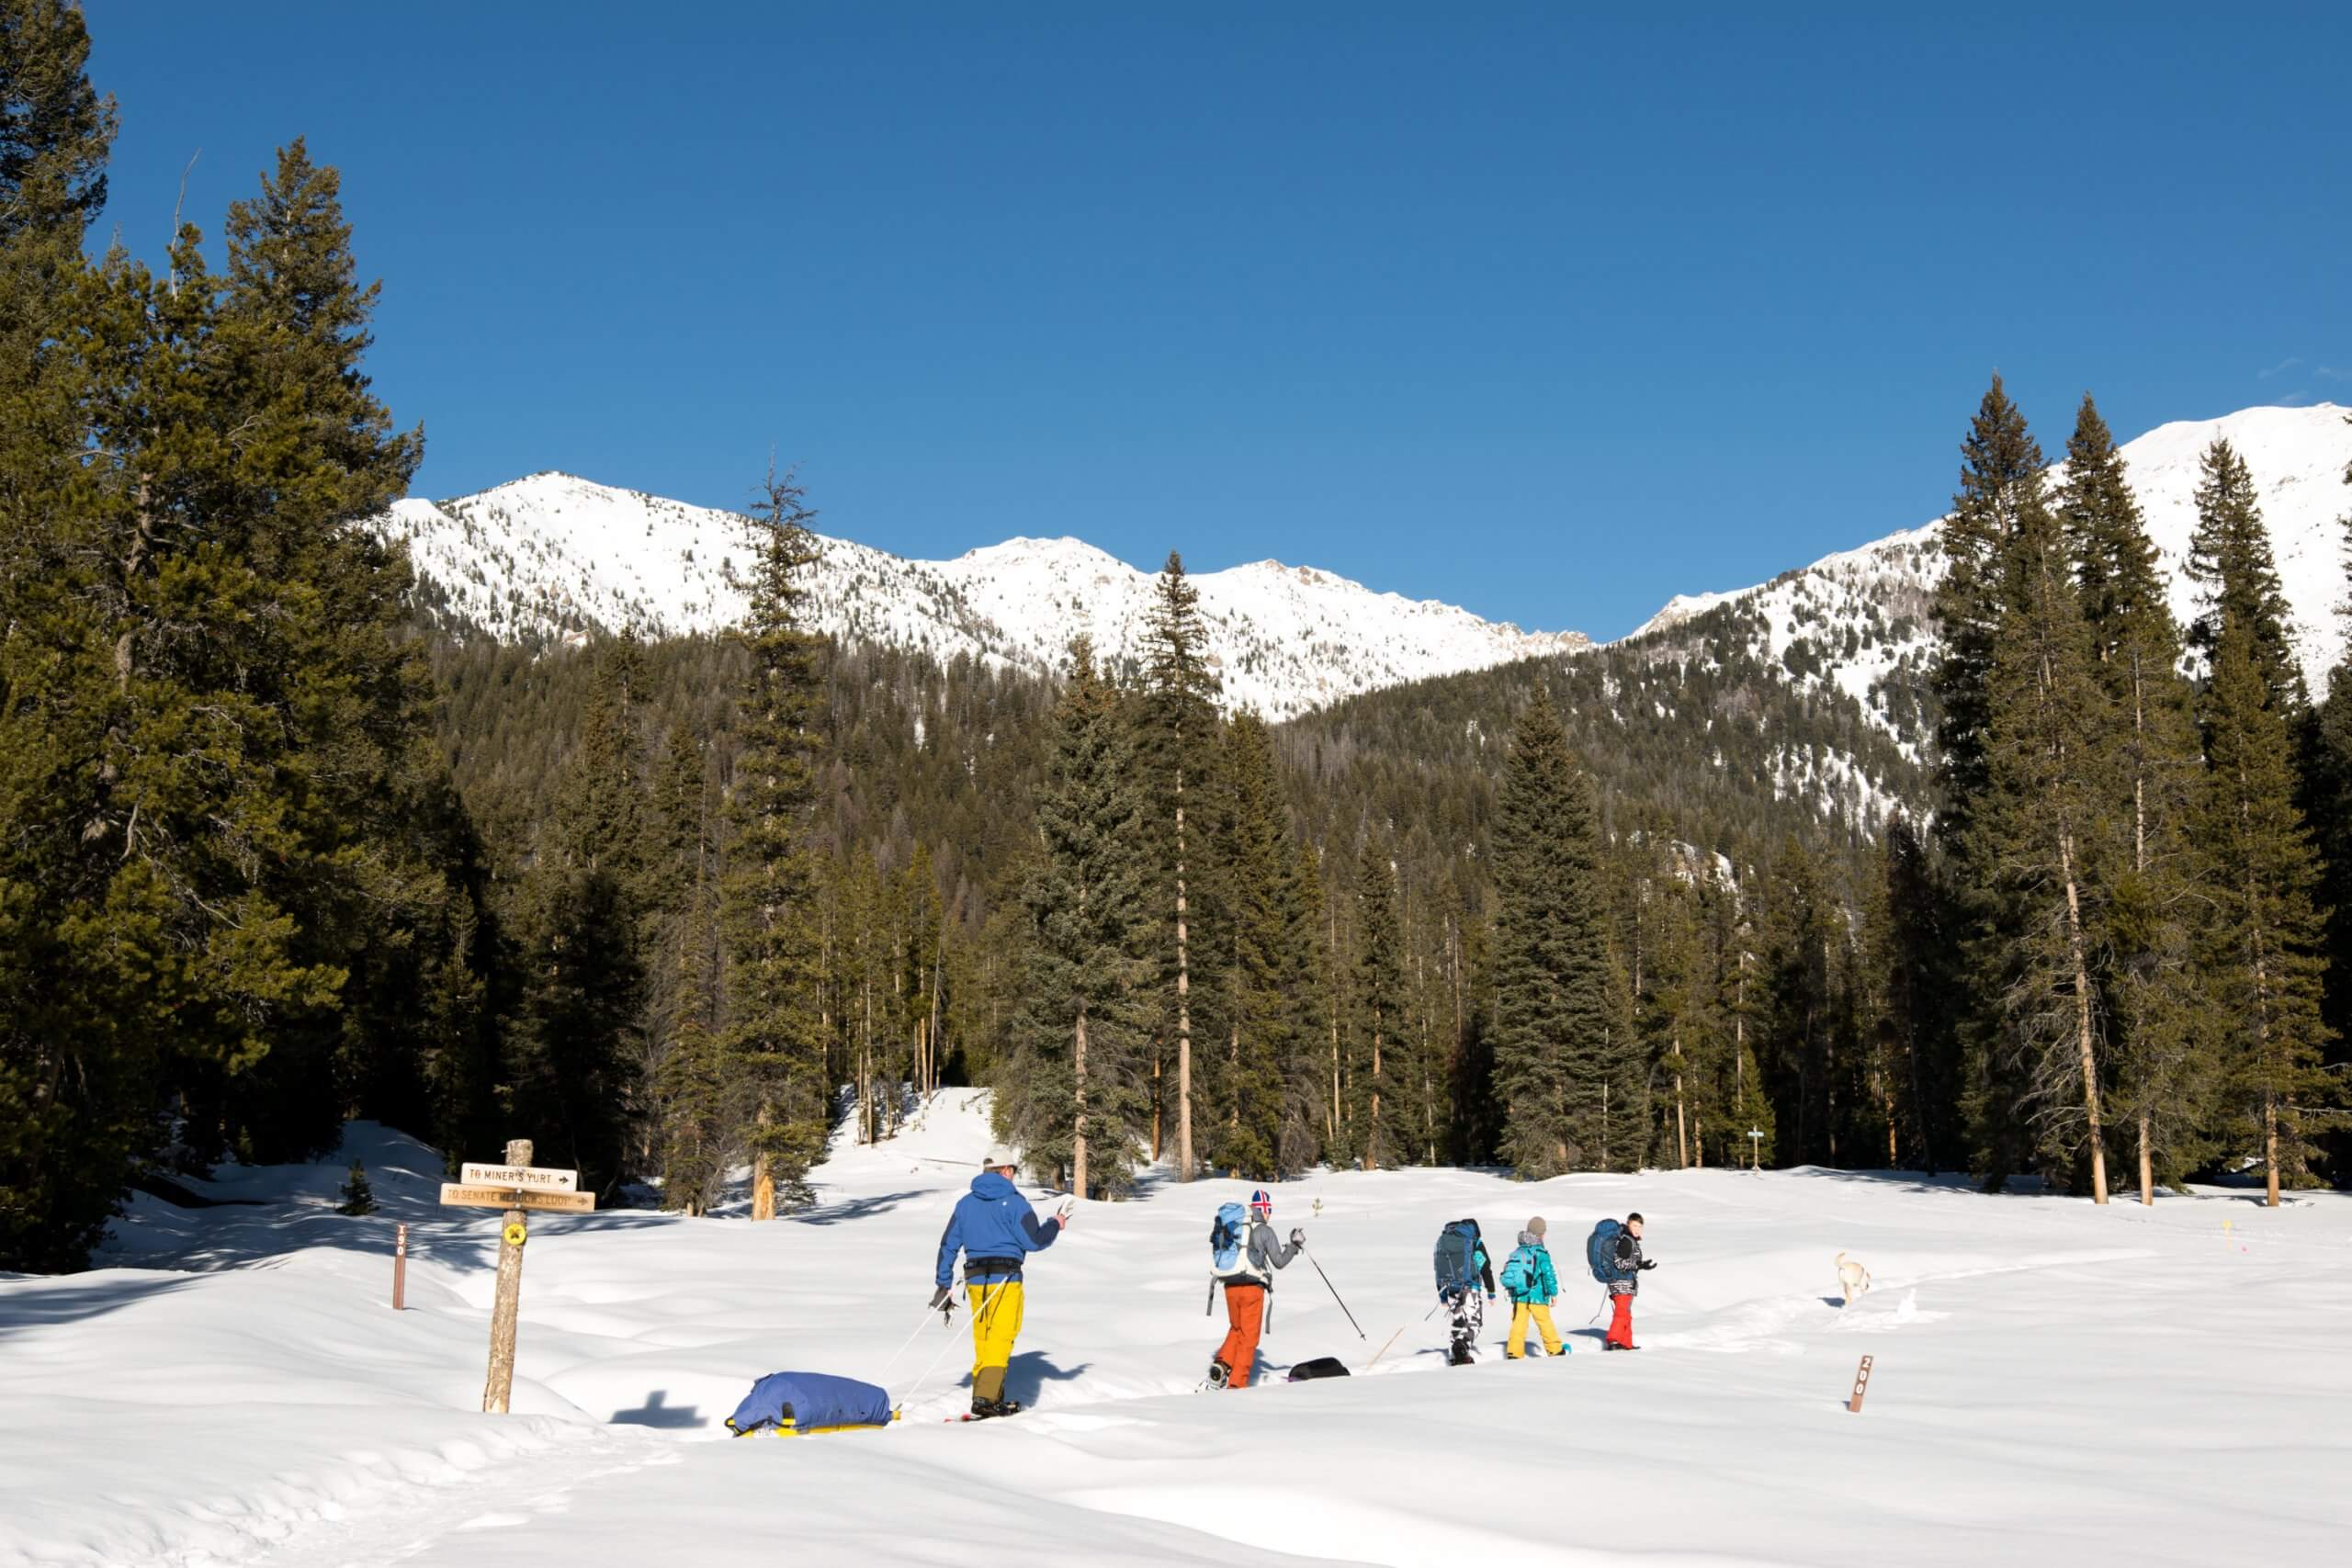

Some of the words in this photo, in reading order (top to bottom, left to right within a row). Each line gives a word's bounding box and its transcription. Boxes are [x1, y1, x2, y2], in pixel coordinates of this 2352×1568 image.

[470, 1168, 481, 1179] TO
[484, 1170, 524, 1182] MINER'S
[527, 1172, 552, 1184] YURT
[447, 1189, 459, 1200] TO
[461, 1190, 497, 1202] SENATE
[1855, 1357, 1871, 1395] 200
